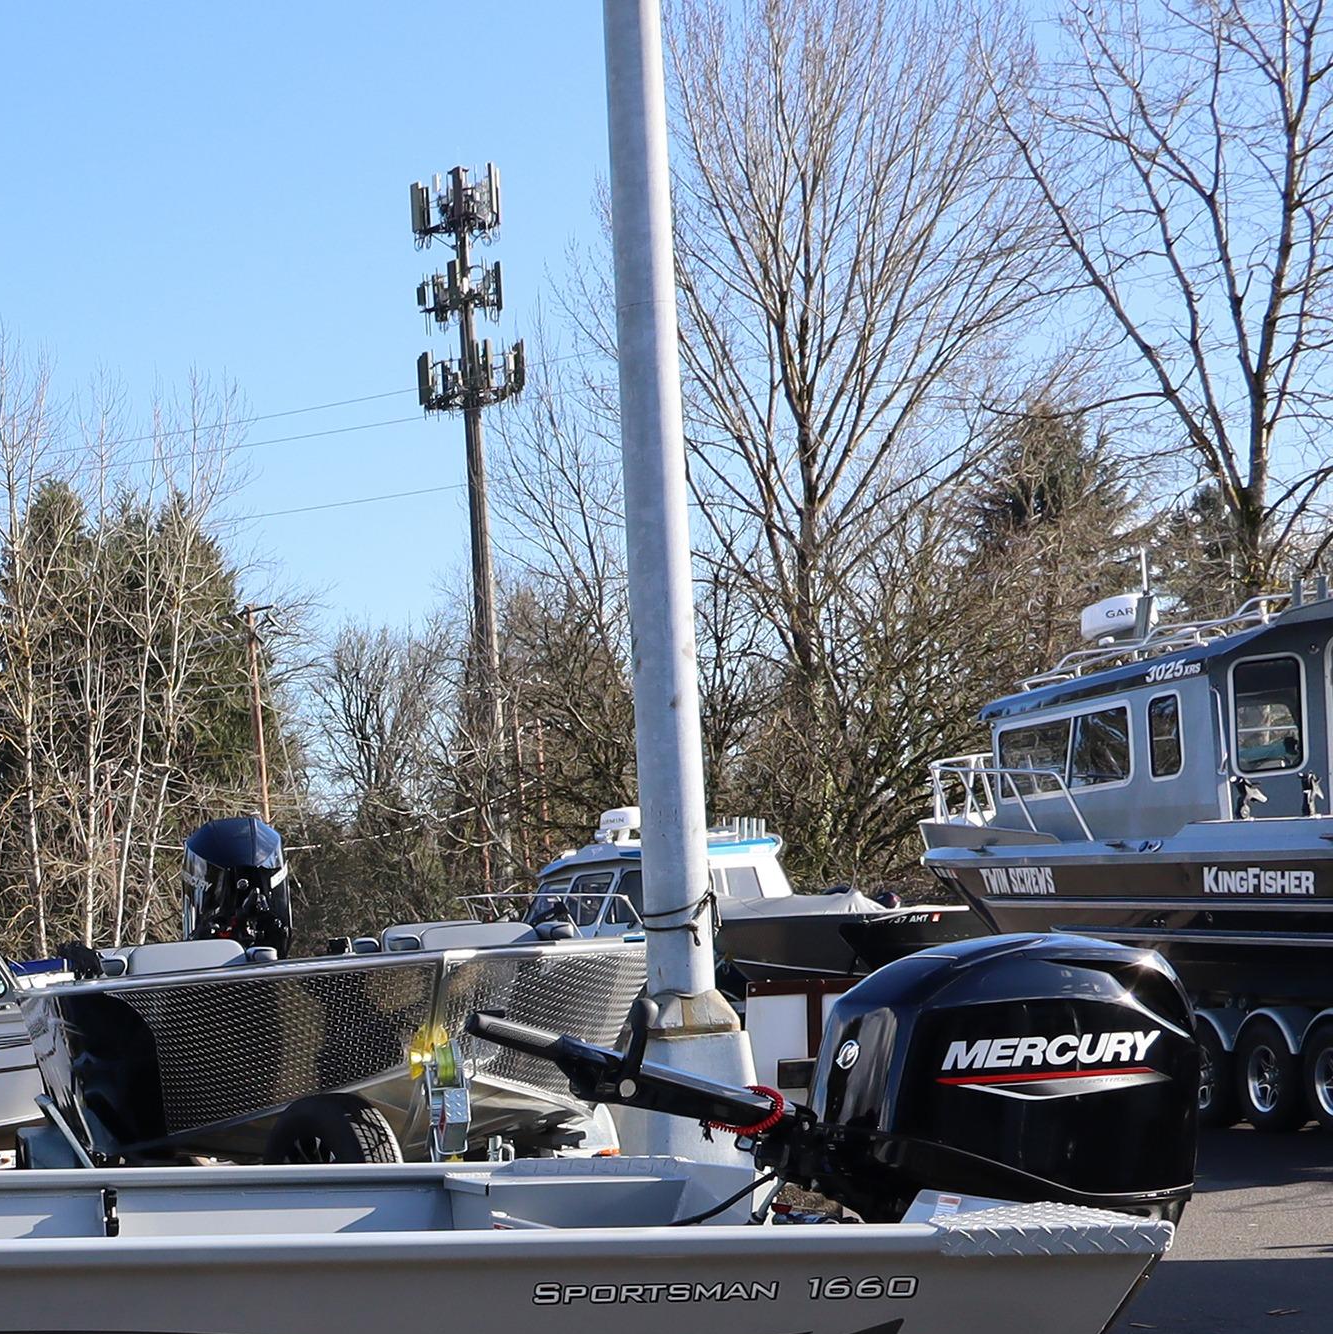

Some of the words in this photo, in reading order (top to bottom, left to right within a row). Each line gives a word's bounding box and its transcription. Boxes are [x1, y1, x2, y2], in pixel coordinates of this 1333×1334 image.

[1105, 607, 1134, 619] GAR
[979, 867, 1011, 894] TWIN
[1008, 866, 1056, 895] SCREWS
[941, 1030, 1161, 1071] MERCURY
[807, 1275, 920, 1300] 1660
